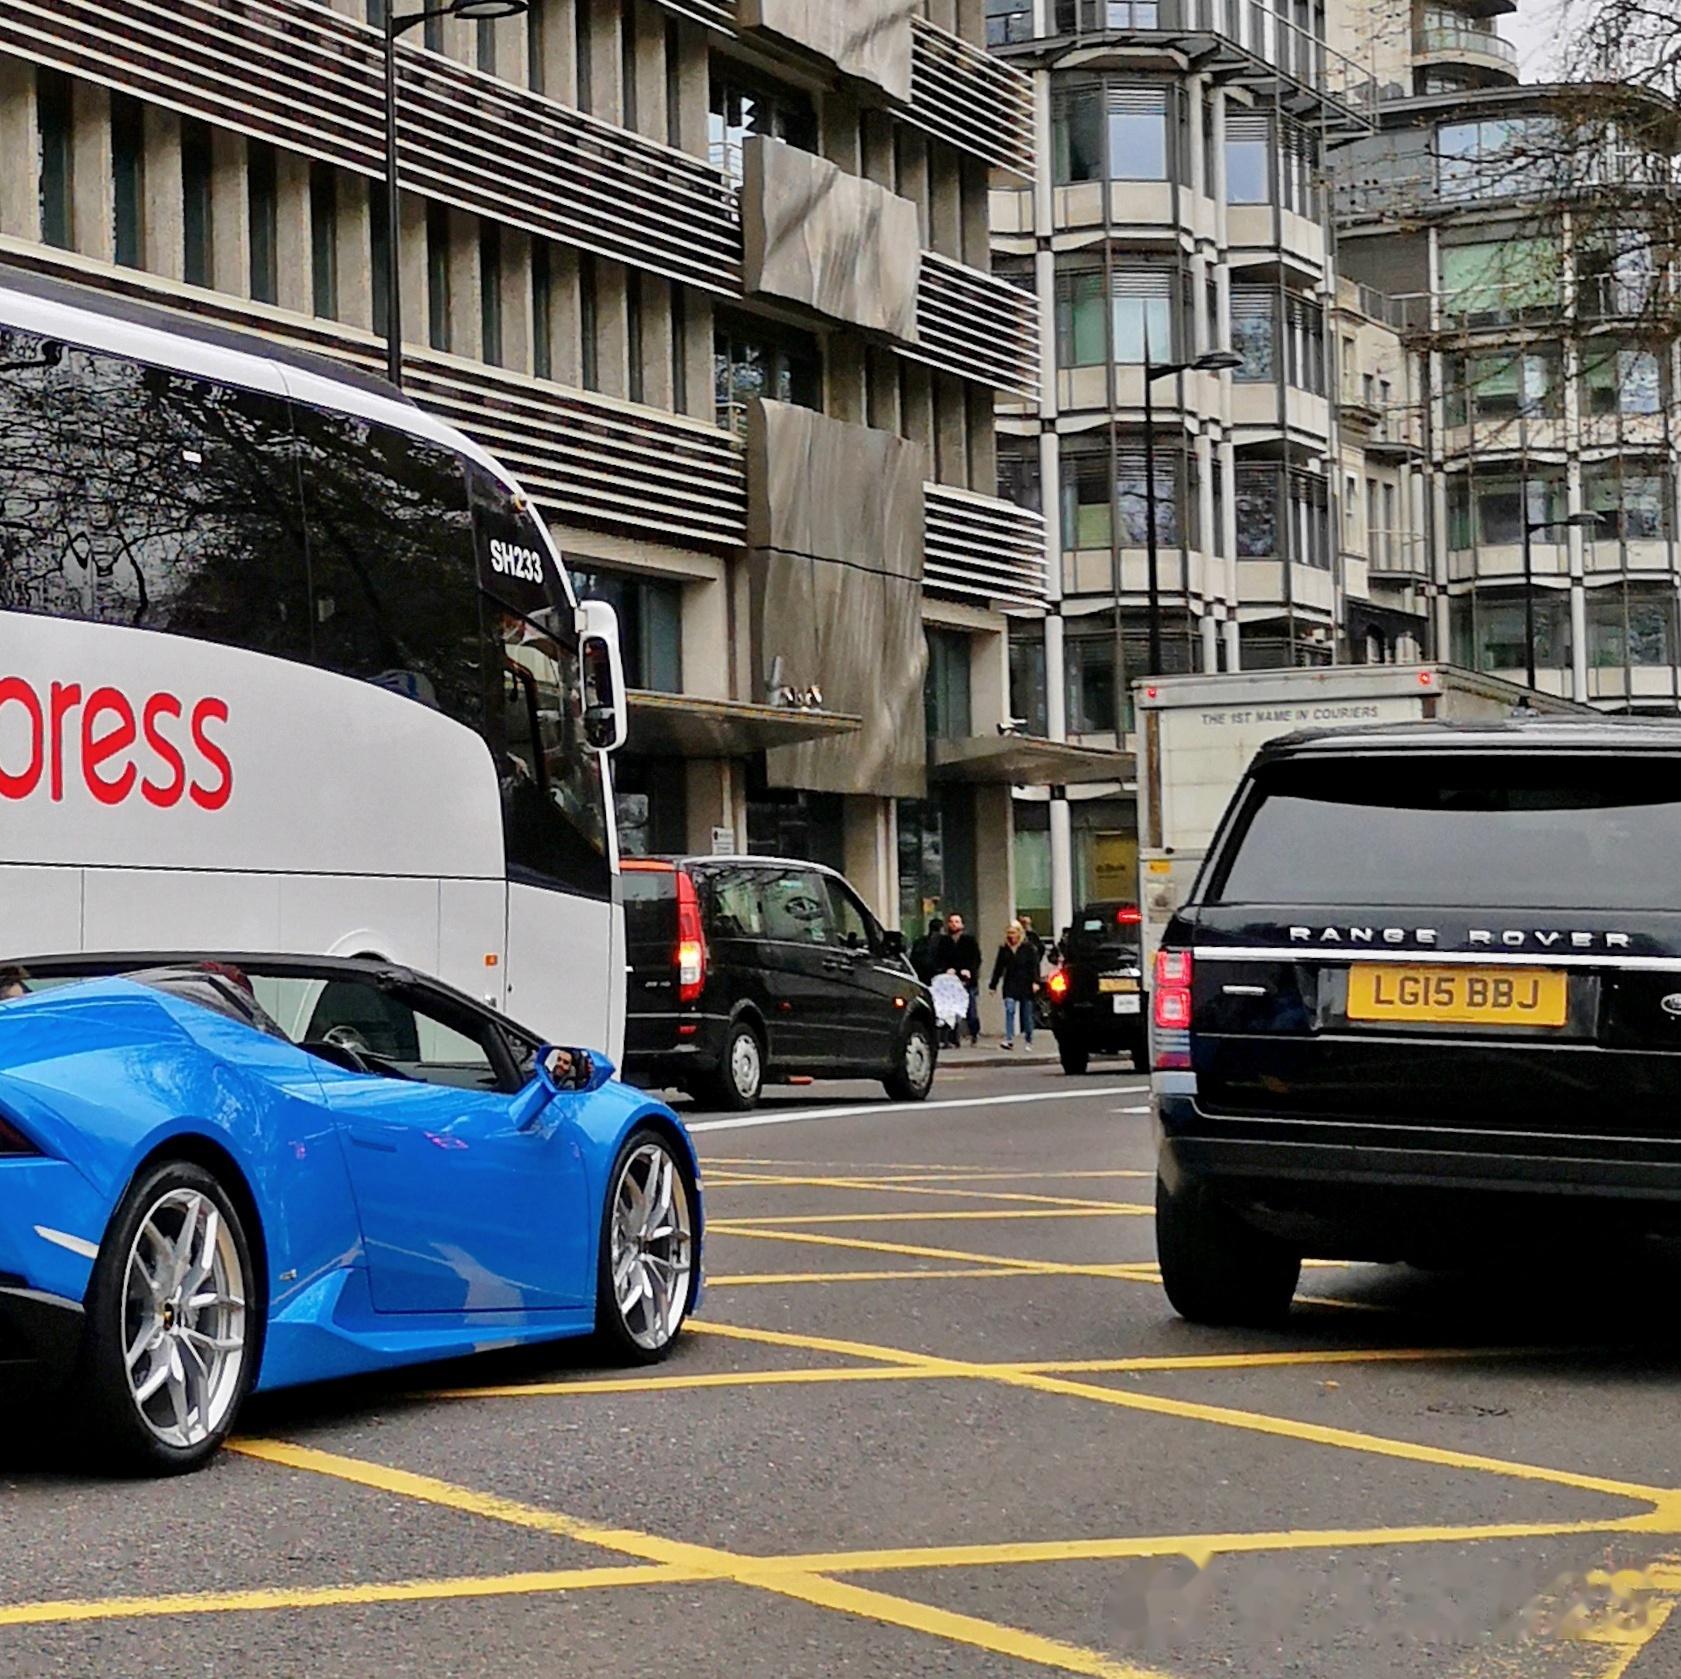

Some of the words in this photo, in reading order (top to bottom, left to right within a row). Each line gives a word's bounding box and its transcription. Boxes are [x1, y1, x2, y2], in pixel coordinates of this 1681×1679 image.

[490, 539, 543, 584] SH233
[1201, 713, 1225, 725] THE
[1256, 709, 1293, 723] NAME
[1296, 709, 1310, 721] IN
[1314, 705, 1378, 720] COURIERS
[1289, 926, 1438, 944] RANGE
[1469, 929, 1633, 949] ROVER
[1374, 974, 1456, 1006] LG15
[1467, 977, 1540, 1010] BBJ
